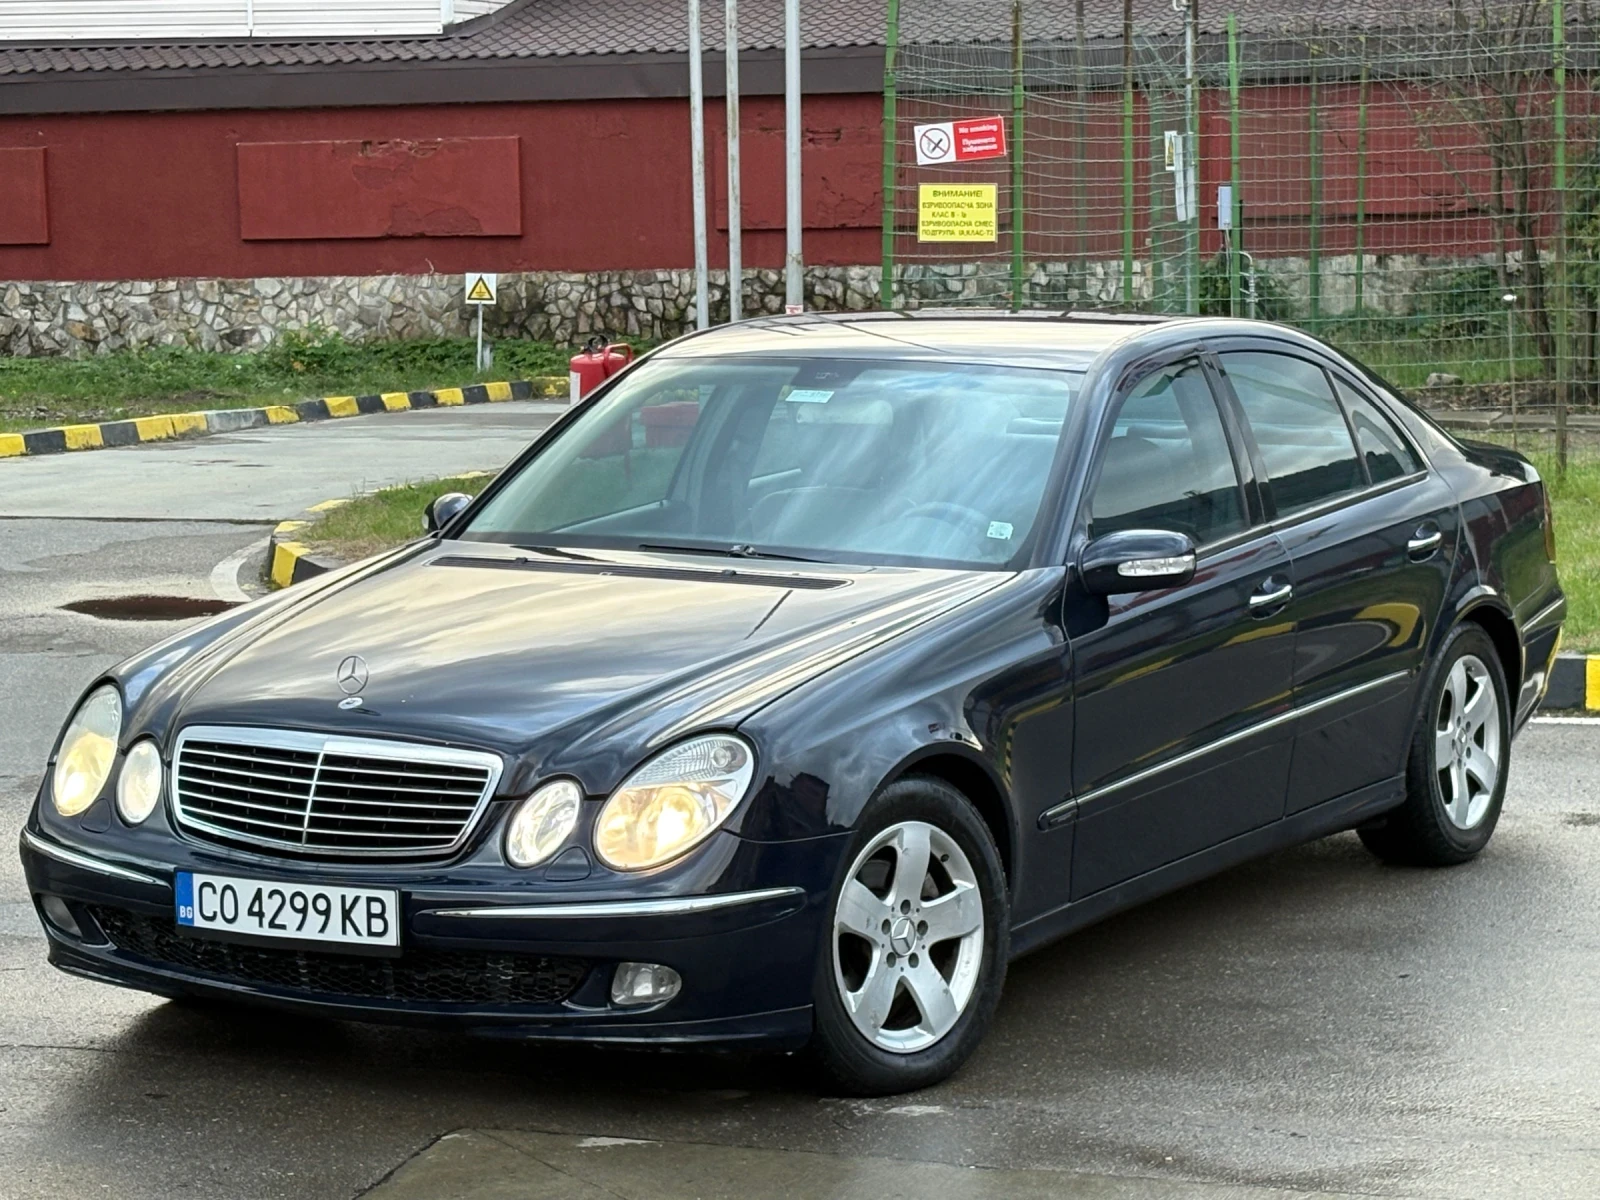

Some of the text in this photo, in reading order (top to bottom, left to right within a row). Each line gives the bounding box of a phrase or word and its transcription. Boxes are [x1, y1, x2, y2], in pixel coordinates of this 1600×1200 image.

[970, 124, 998, 133] smoking
[932, 190, 983, 198] ВНИМАНИЕ!
[179, 905, 194, 919] BG
[247, 887, 332, 934] 4299
[340, 894, 389, 938] KB
